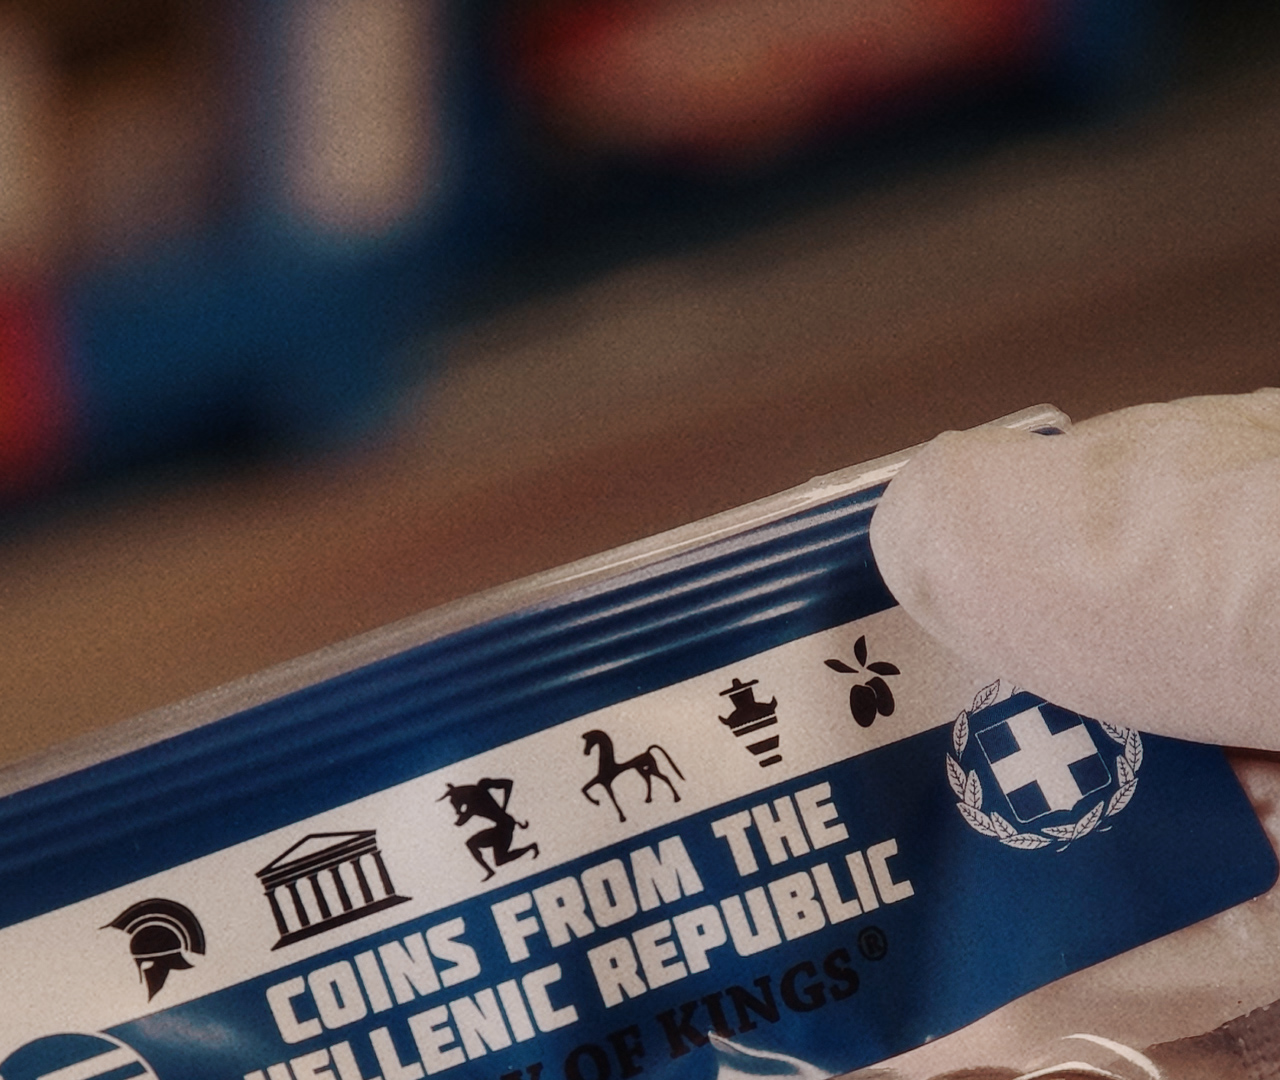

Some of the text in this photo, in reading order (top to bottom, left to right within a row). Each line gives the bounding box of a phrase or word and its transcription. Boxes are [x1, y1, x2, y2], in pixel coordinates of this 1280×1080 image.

[266, 781, 851, 1046] COINS FROM THE
[587, 838, 915, 1010] REPUBLIC
